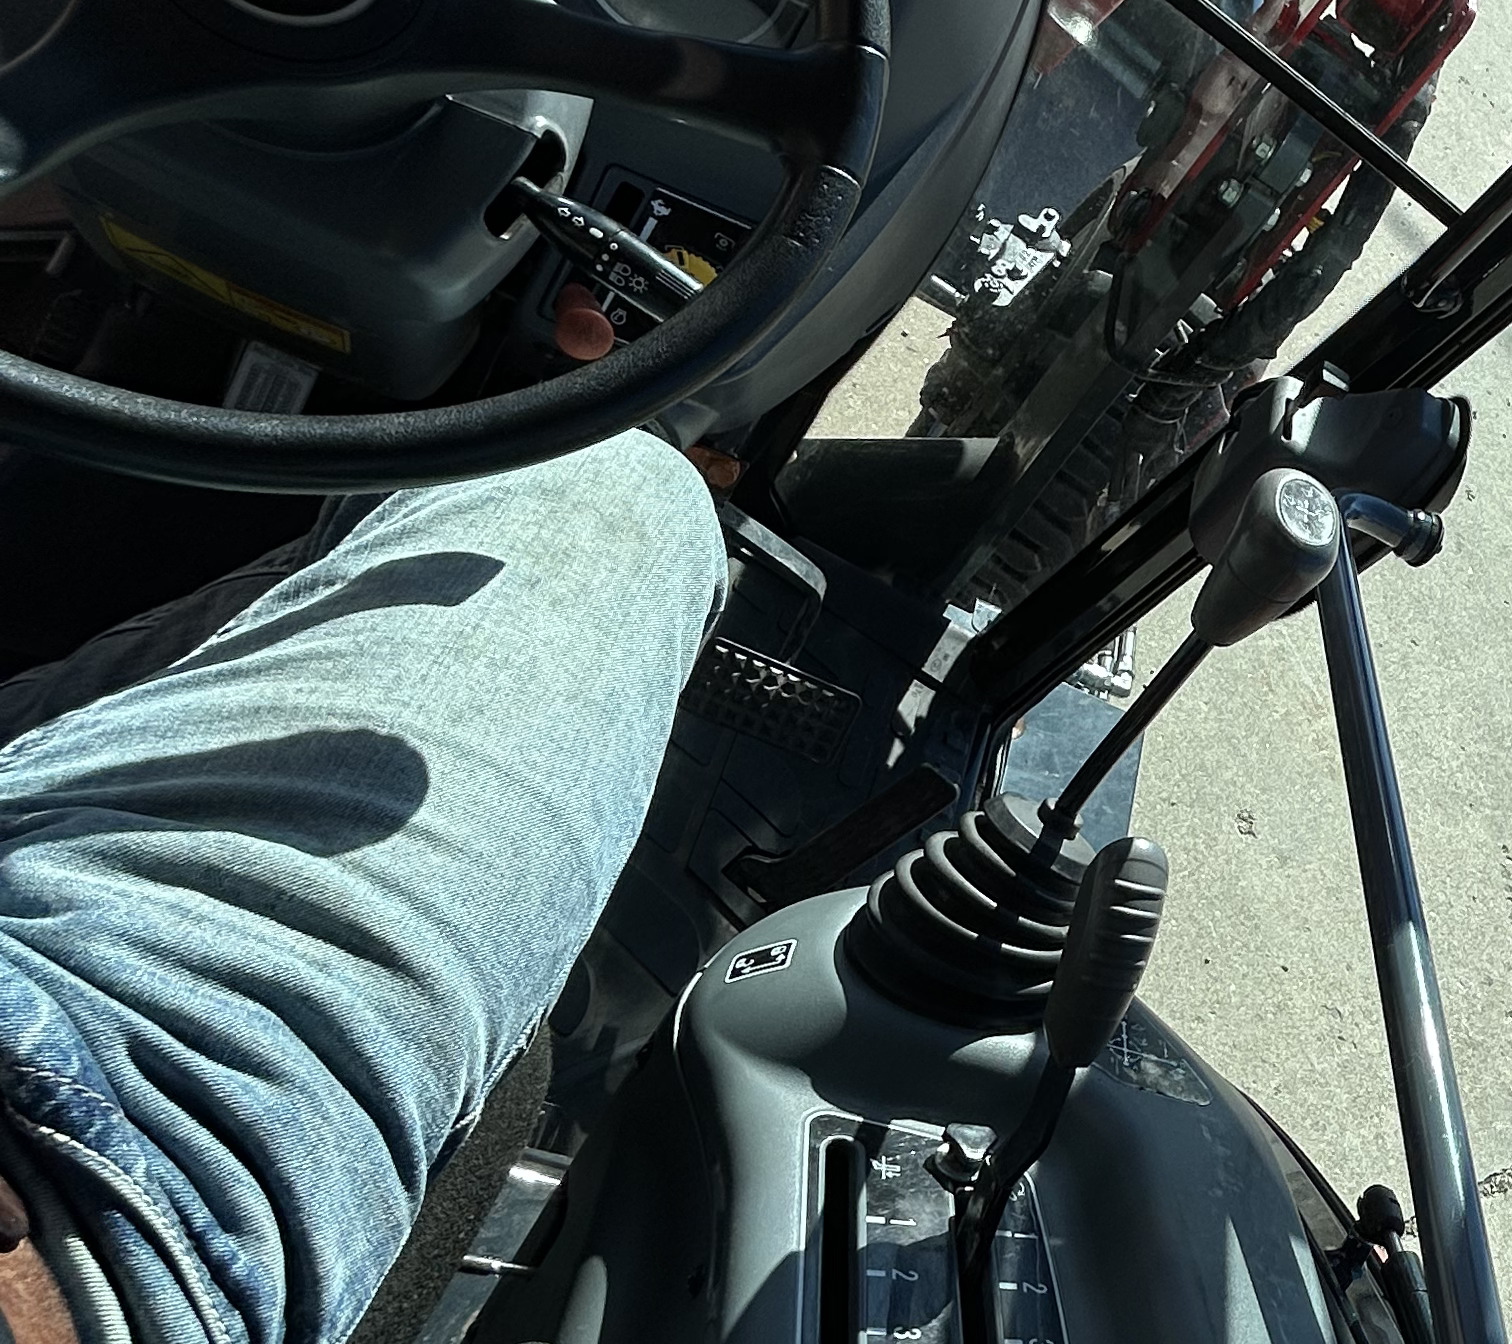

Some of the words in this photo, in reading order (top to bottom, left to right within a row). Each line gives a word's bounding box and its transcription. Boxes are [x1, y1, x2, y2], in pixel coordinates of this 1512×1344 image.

[891, 1268, 919, 1281] 2
[1022, 1281, 1048, 1294] 2
[893, 1326, 922, 1340] 3
